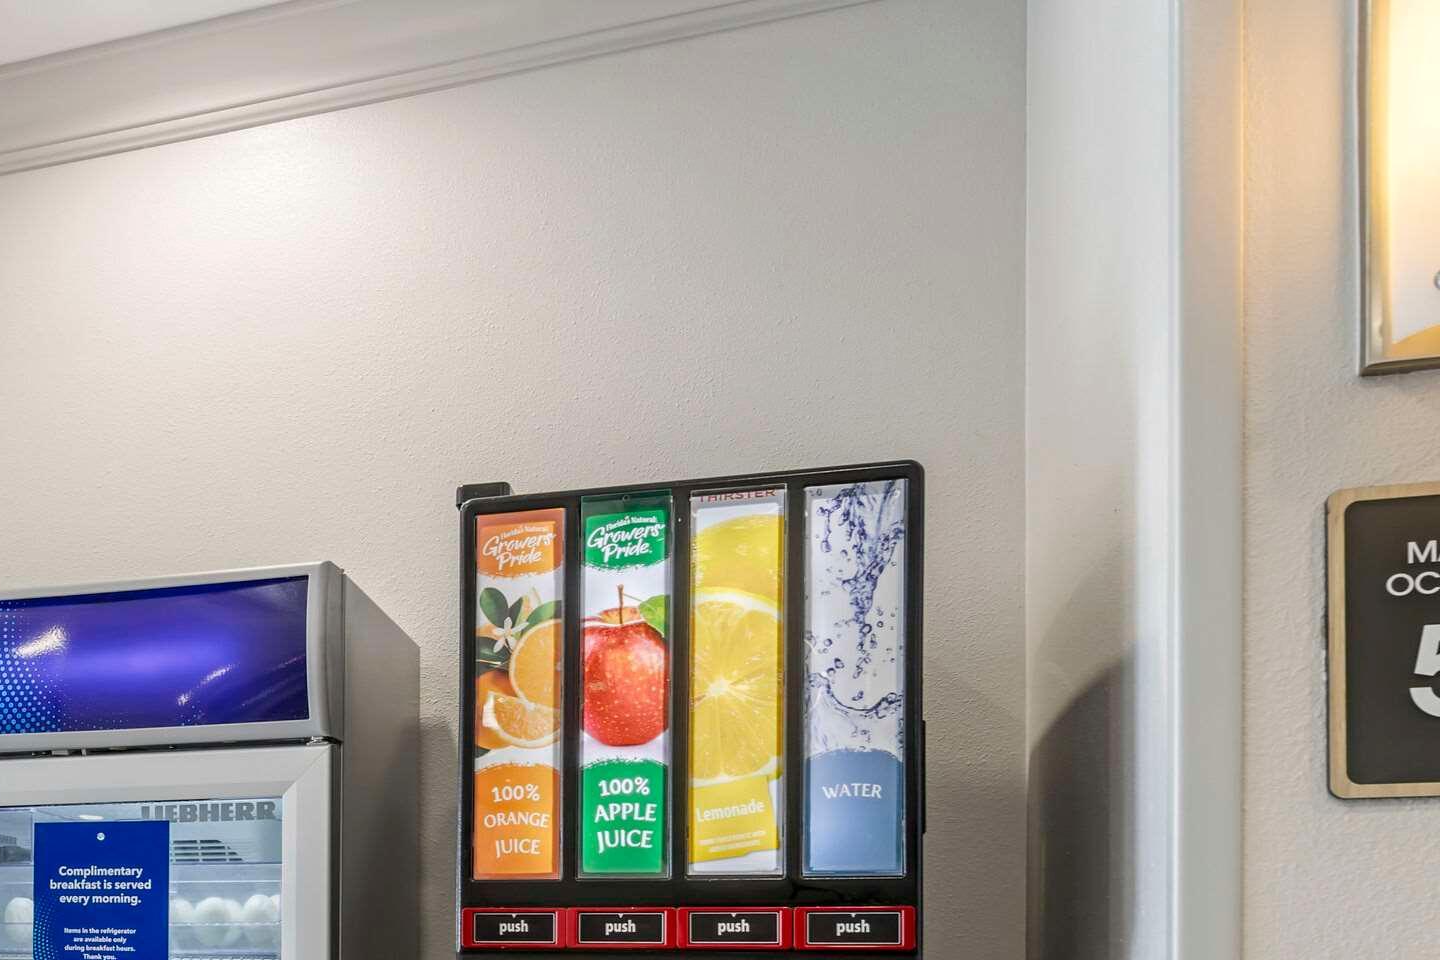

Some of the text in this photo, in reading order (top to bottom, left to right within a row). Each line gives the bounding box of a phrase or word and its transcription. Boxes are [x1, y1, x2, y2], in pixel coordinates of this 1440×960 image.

[700, 488, 777, 503] THIRSTER
[482, 532, 556, 556] Growers
[587, 523, 666, 549] Growers
[496, 550, 542, 571] Pride
[1407, 540, 1440, 564] M
[491, 783, 541, 803] 100%
[598, 776, 651, 797] 100%
[822, 783, 883, 799] WATER
[141, 801, 276, 824] LIEBHERR
[483, 811, 551, 829] ORANGE
[594, 802, 657, 823] APPLE
[696, 799, 765, 823] Lemonade
[495, 838, 542, 858] JUICE
[596, 829, 655, 854] JUICE
[58, 865, 143, 878] Complimentary
[49, 879, 152, 890] breakfast is served
[59, 893, 142, 906] every morning.
[499, 920, 529, 934] push
[605, 920, 637, 934] push
[717, 920, 750, 934] push
[836, 920, 870, 934] push
